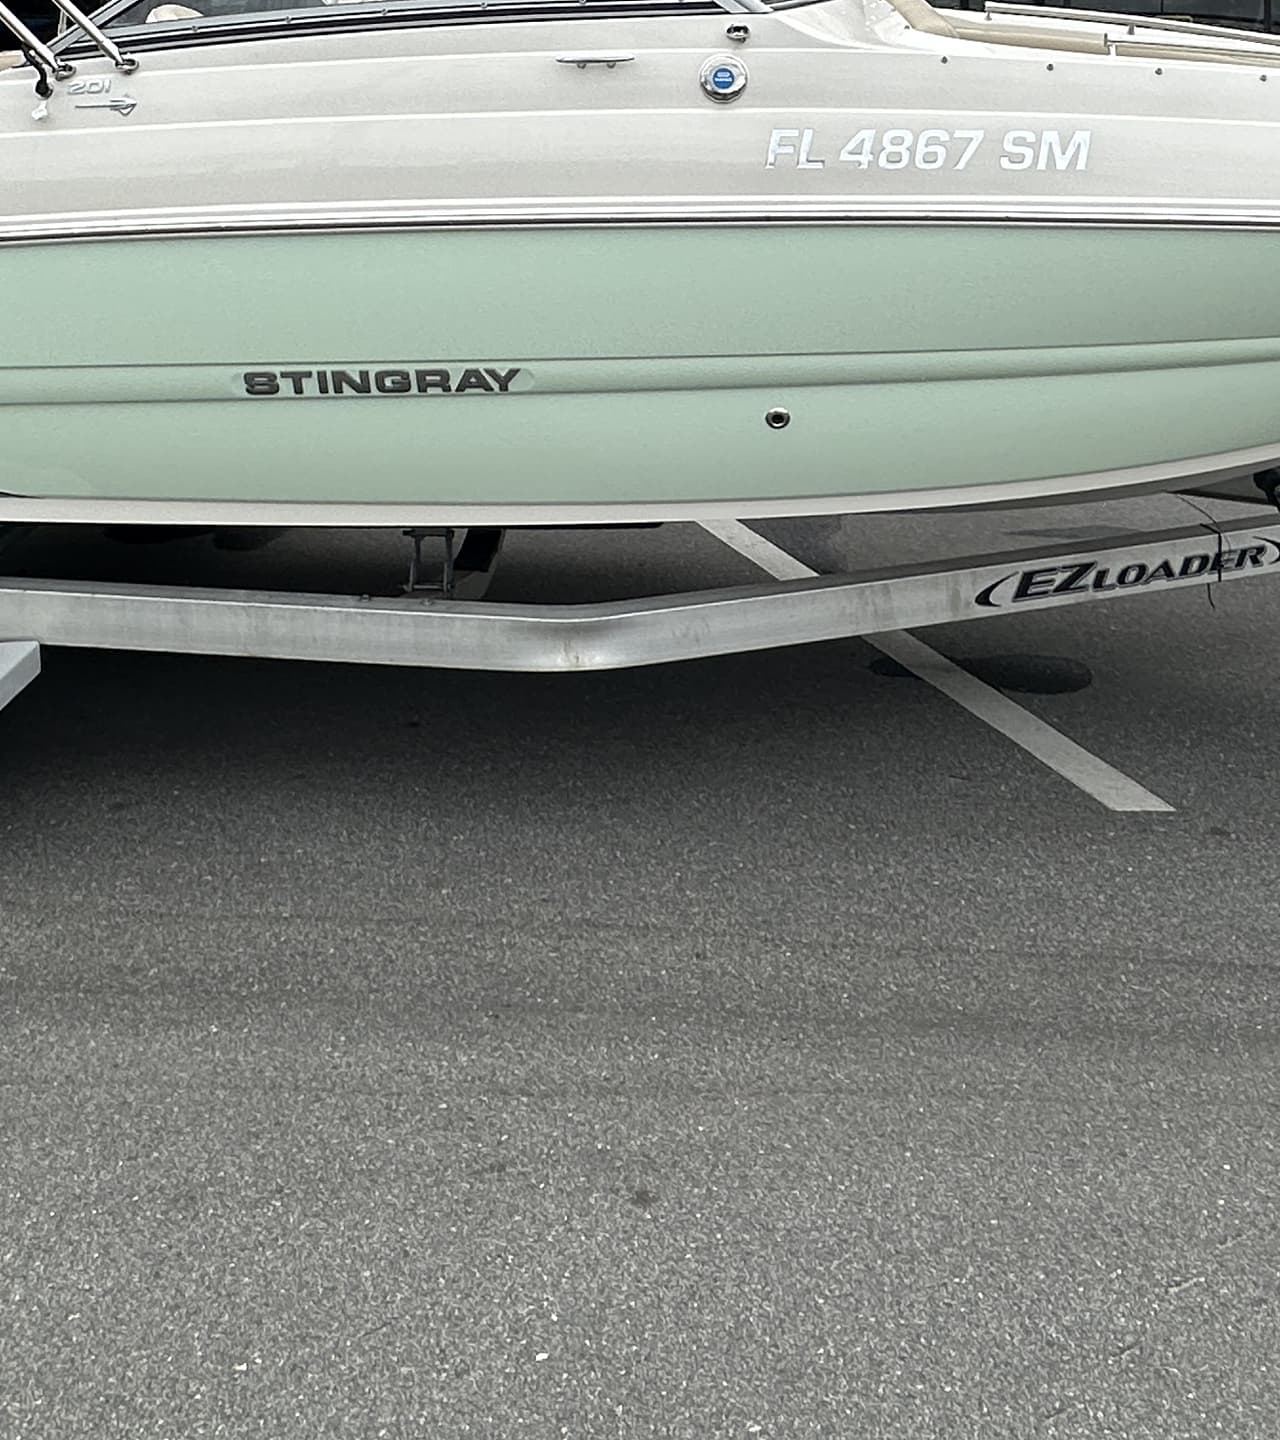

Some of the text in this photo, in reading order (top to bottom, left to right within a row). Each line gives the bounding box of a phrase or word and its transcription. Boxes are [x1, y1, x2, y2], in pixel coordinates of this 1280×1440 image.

[67, 79, 112, 95] 201
[764, 128, 1093, 172] FL 4867 SM
[243, 368, 521, 396] STINGRAY
[1011, 544, 1267, 603] EZLOADER
